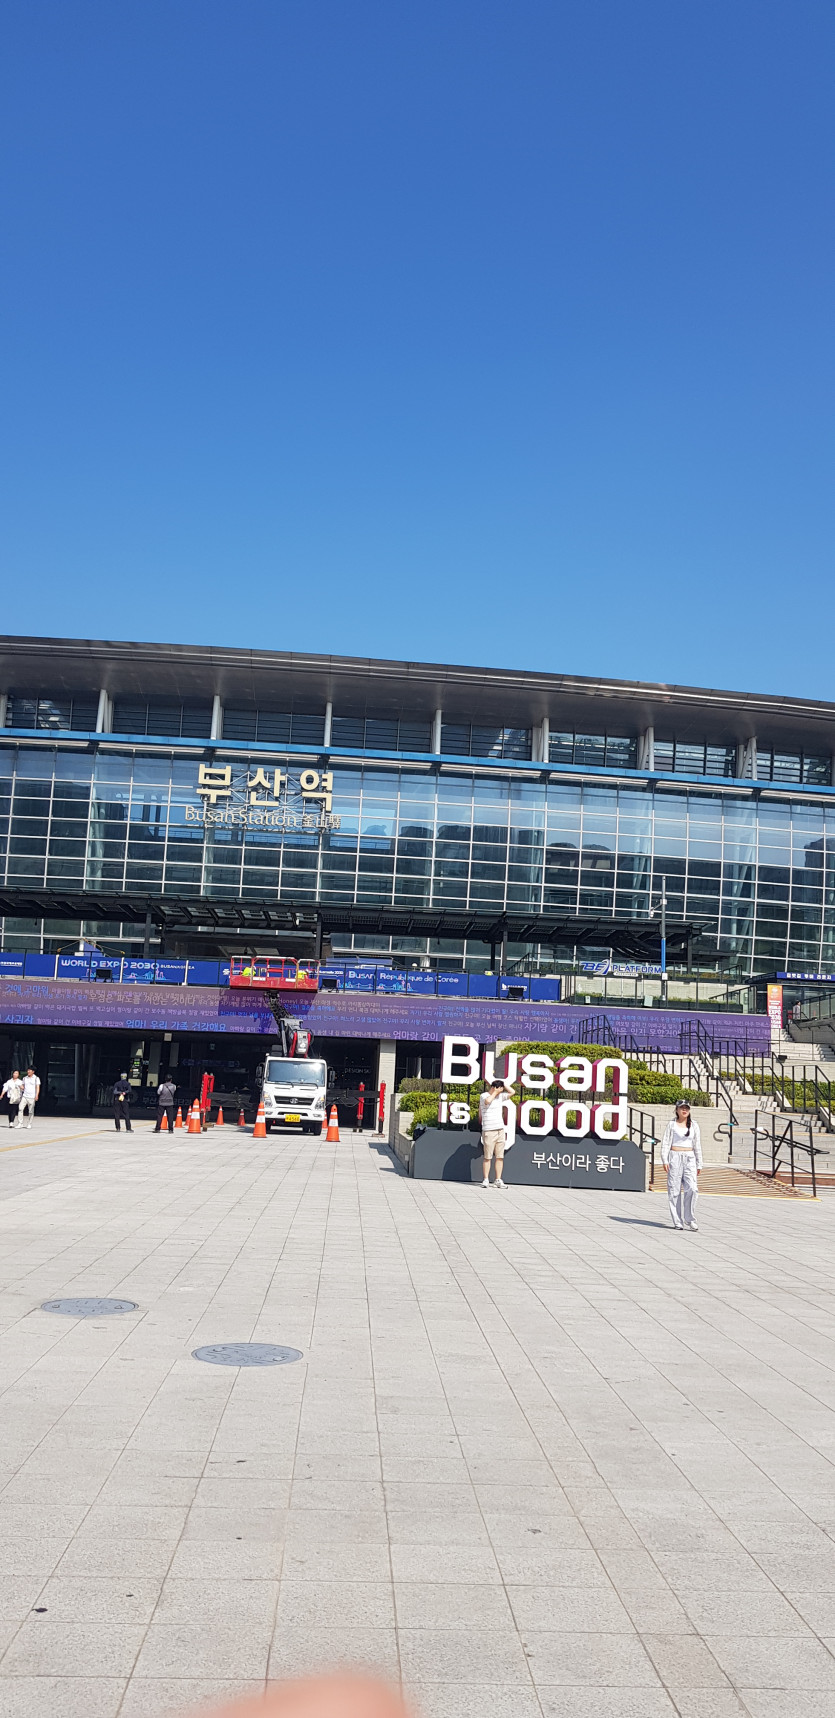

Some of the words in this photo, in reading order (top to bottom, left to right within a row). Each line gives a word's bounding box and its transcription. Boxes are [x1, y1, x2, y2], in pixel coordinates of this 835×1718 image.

[196, 763, 334, 811] 부산역
[185, 805, 234, 823] Busan
[239, 810, 297, 827] Station
[61, 959, 98, 968] WORLD
[99, 961, 129, 969] EXPO
[130, 961, 159, 970] 2030
[612, 964, 662, 974] PLATFORM
[125, 1019, 147, 1029] 엄마!
[150, 1020, 168, 1029] 우리
[171, 1020, 189, 1030] 가족
[524, 1022, 547, 1032] 자기랑
[551, 1023, 567, 1034] 같이
[392, 1030, 419, 1040] 엄마랑
[421, 1032, 438, 1042] 같이
[440, 1035, 629, 1093] Busan
[438, 1093, 471, 1125] is
[531, 1151, 592, 1171] 부산이라
[594, 1154, 625, 1173] 좋다
